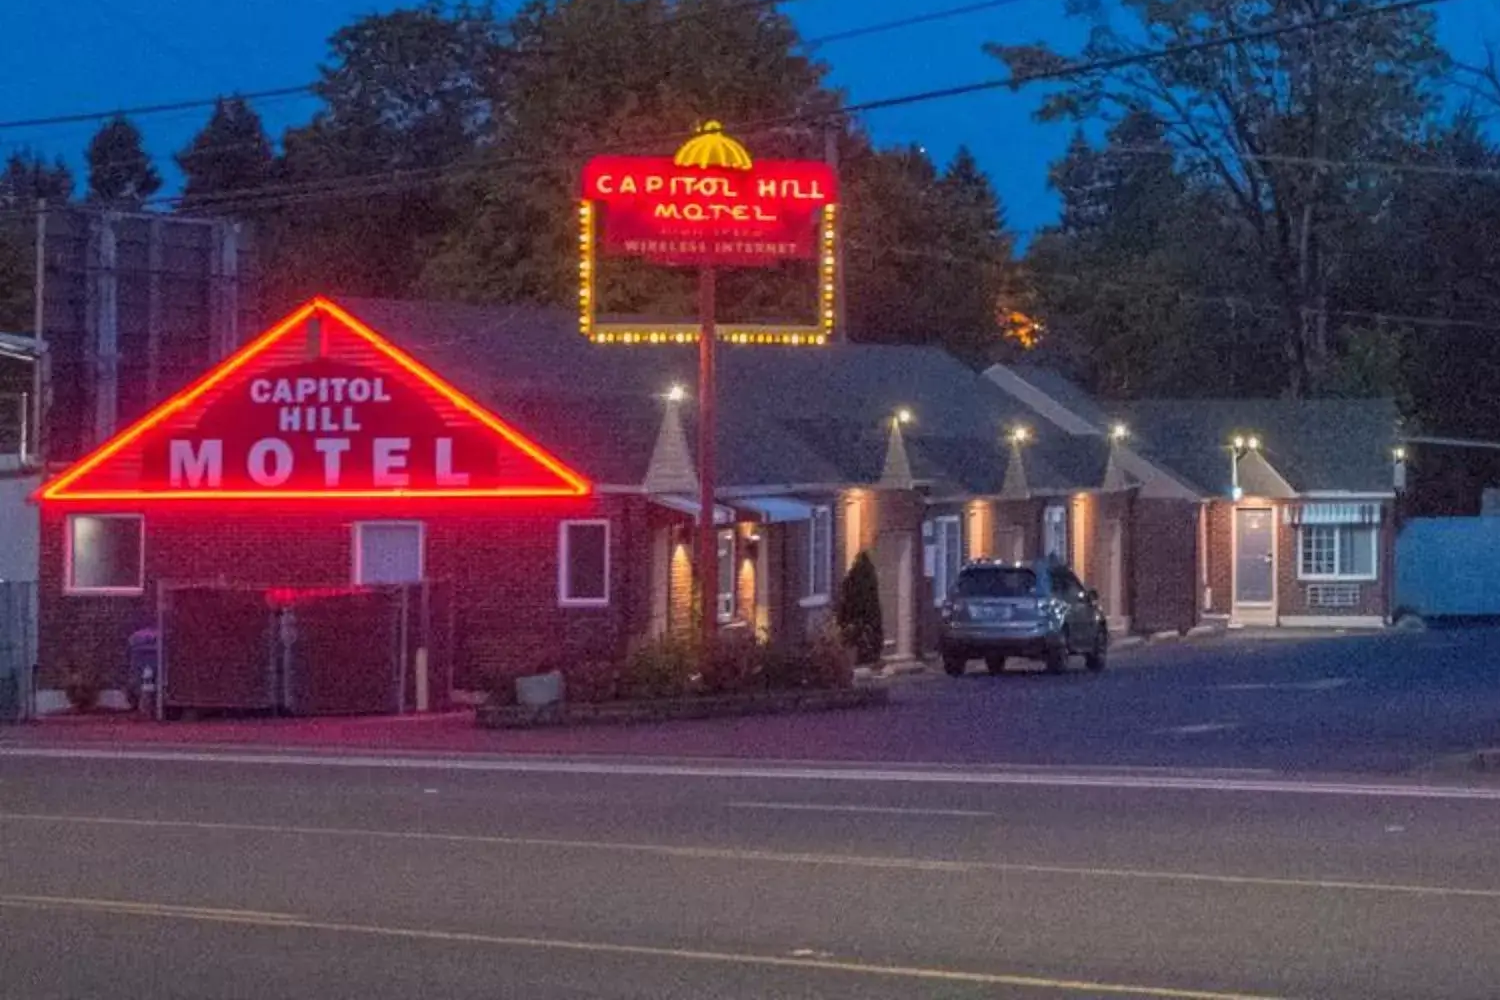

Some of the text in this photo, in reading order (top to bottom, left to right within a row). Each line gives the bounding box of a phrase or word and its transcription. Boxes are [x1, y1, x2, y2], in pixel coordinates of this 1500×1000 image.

[596, 174, 825, 199] CAPITOL HILL
[654, 203, 777, 221] MOTEL
[250, 378, 391, 403] CAPITOL
[278, 406, 361, 431] HILL
[169, 436, 470, 488] MOTEL
